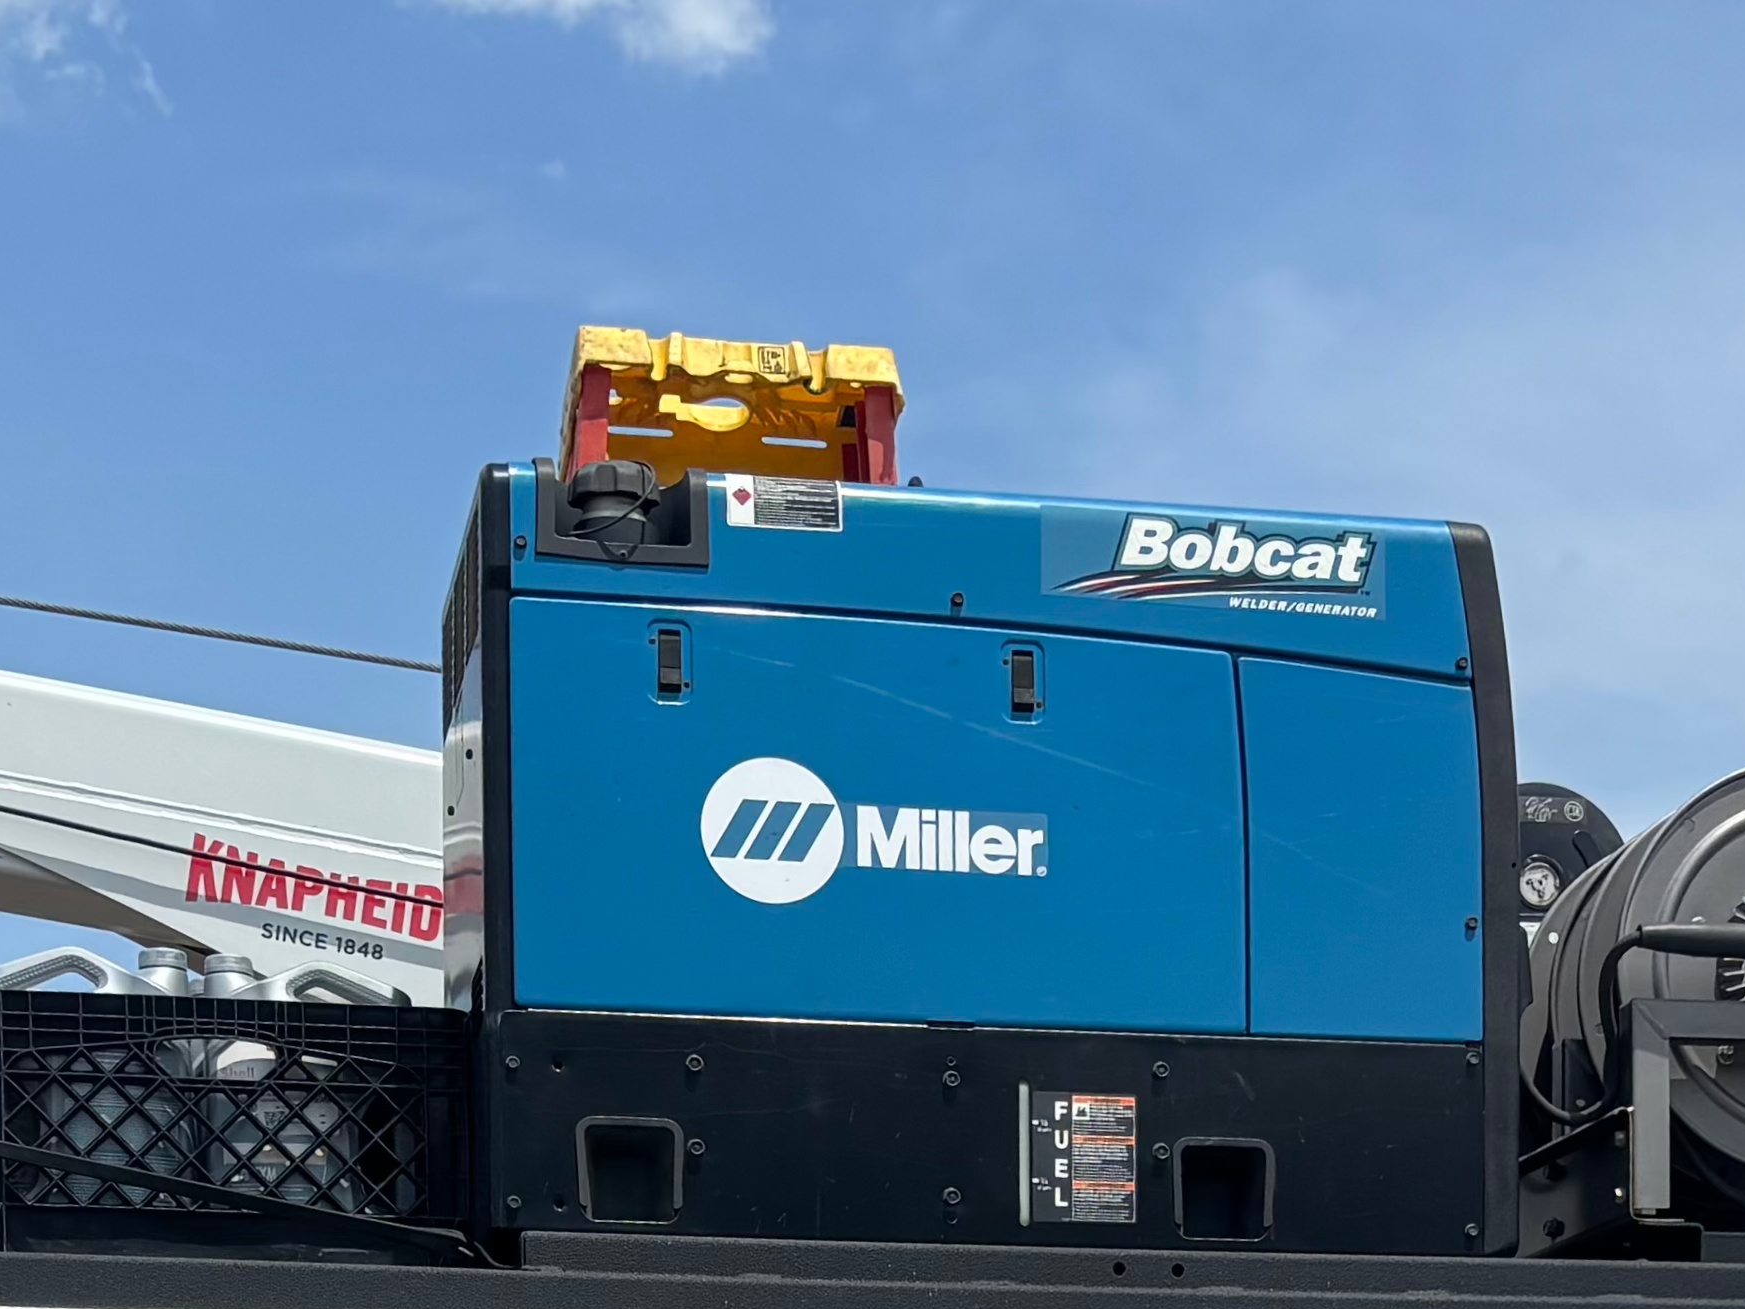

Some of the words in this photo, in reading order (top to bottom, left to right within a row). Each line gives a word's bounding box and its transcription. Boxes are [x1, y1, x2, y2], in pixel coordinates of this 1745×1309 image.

[1119, 517, 1367, 583] Bobcat
[1228, 596, 1378, 618] WELDER/GENERATOR
[856, 805, 1044, 876] Miller
[260, 922, 329, 950] SINCE
[335, 936, 384, 960] 1848
[1054, 1101, 1069, 1207] FUEL
